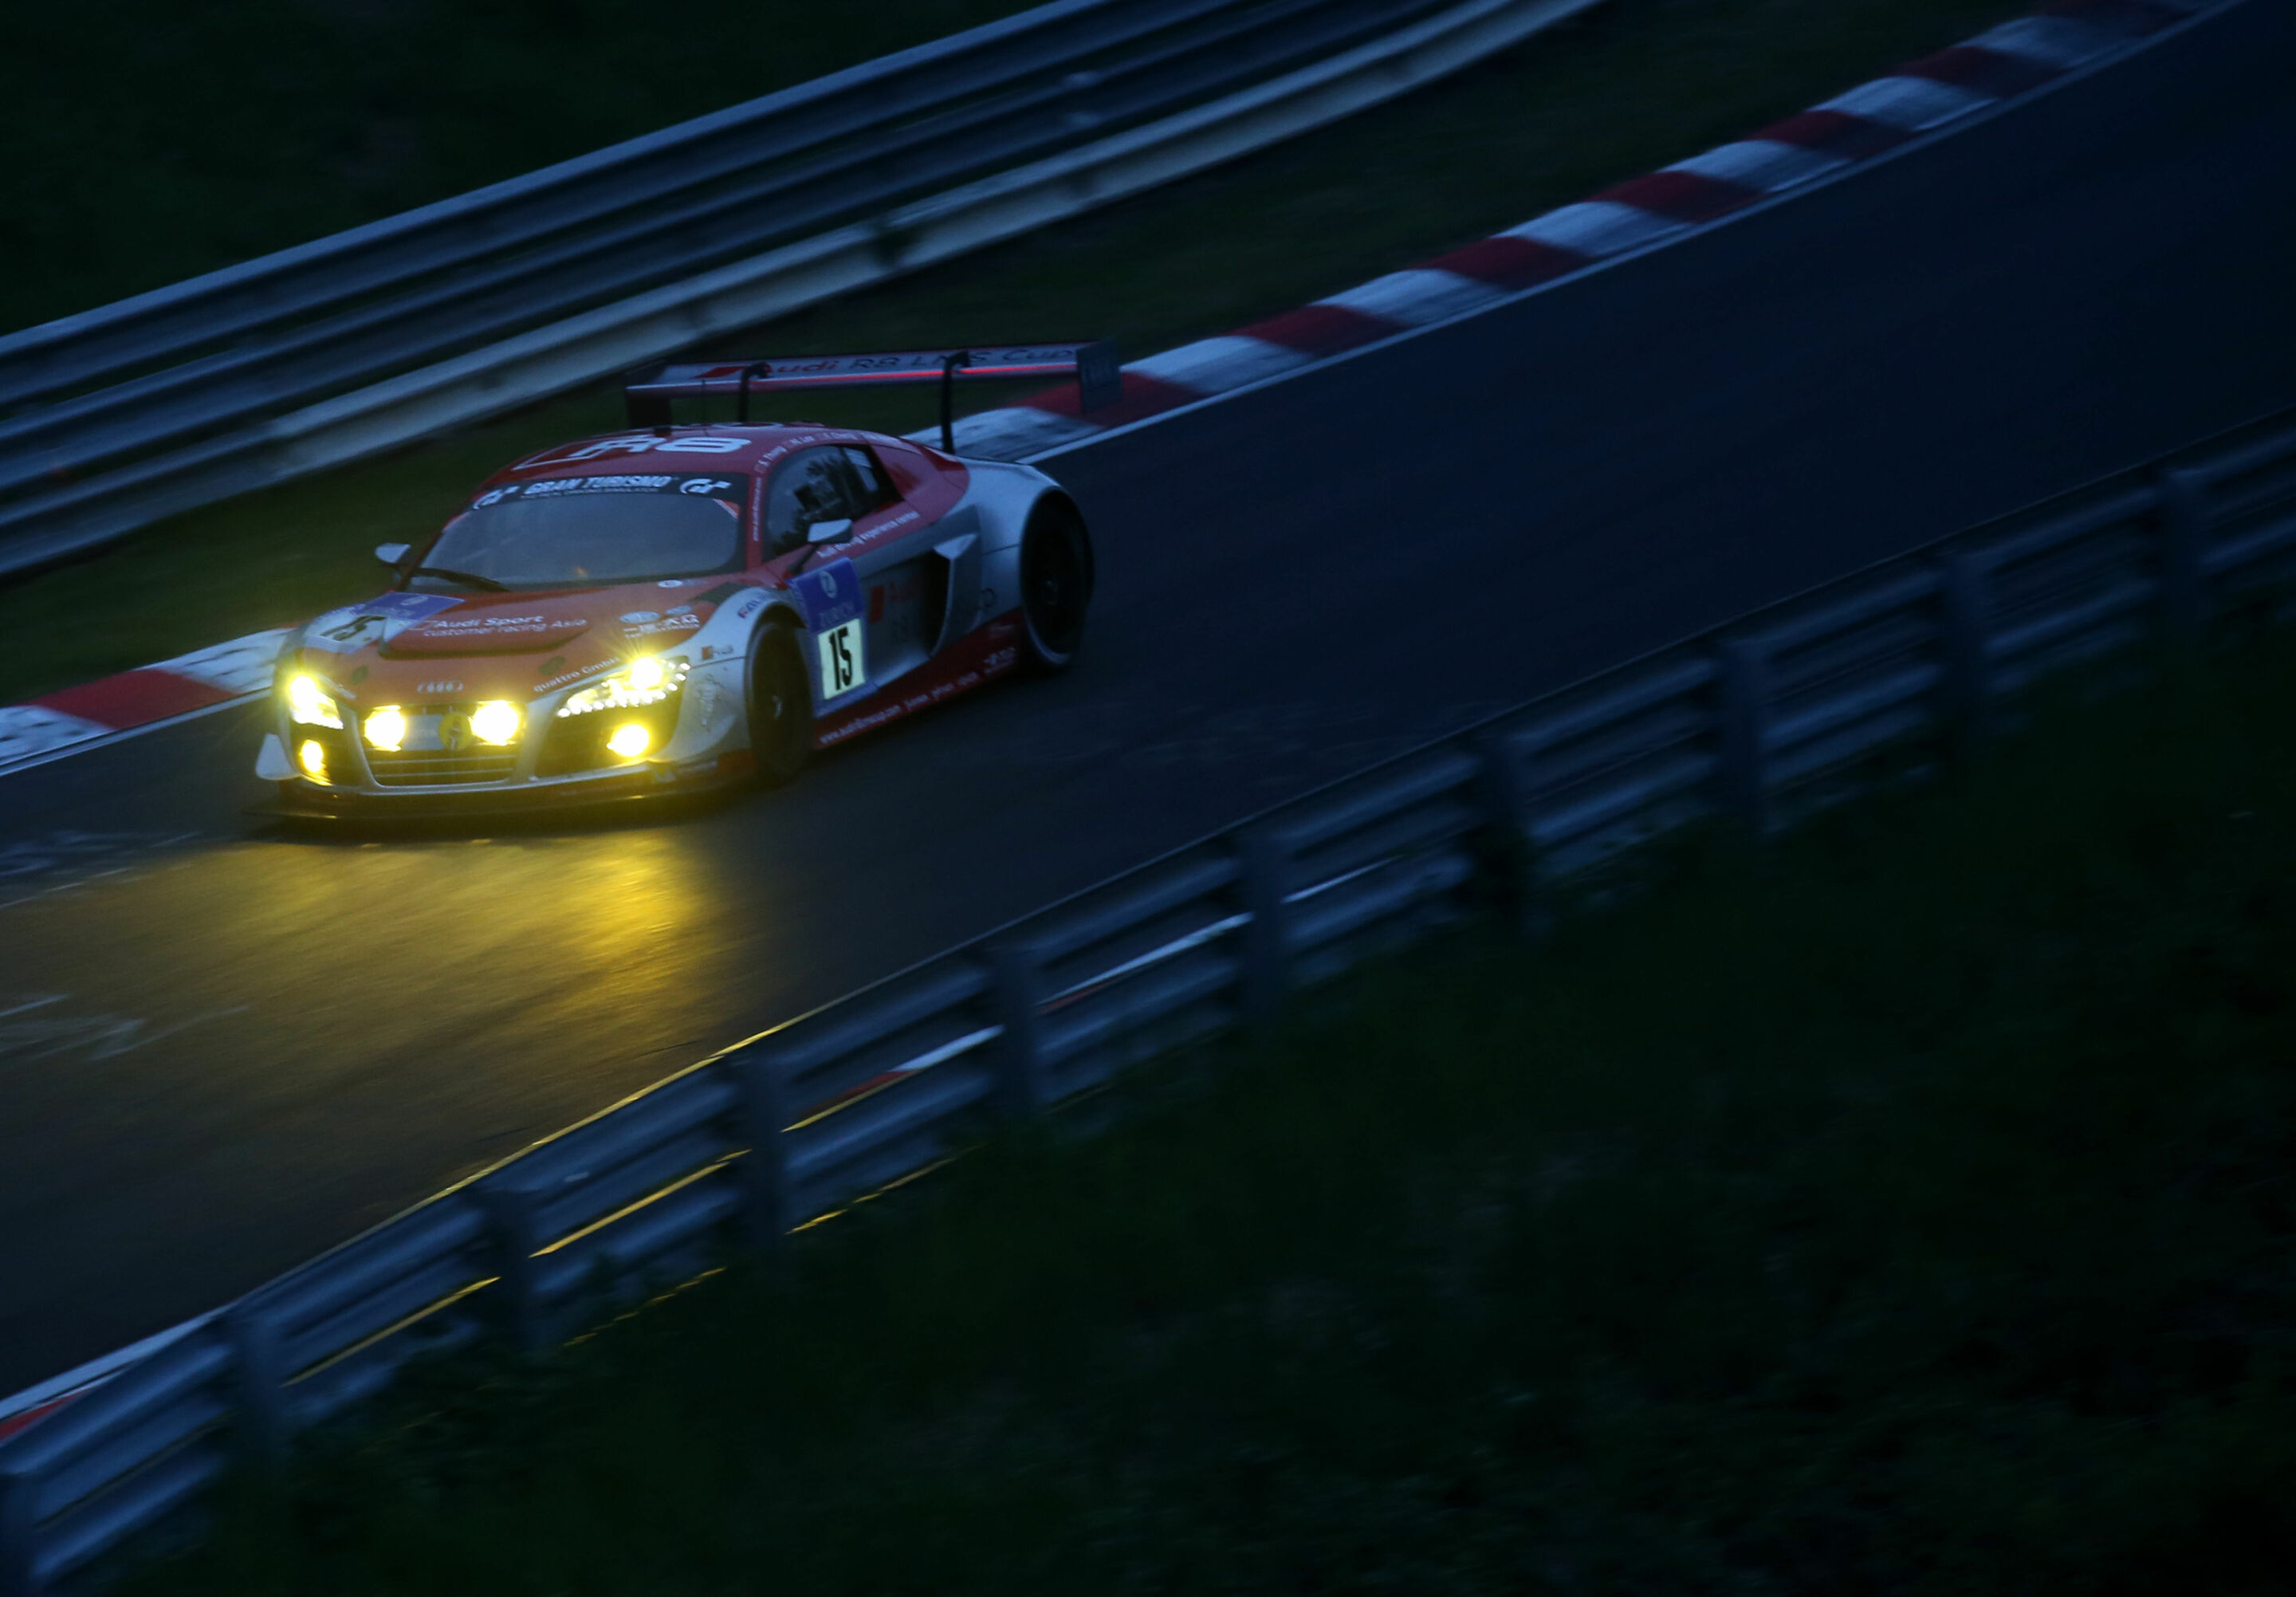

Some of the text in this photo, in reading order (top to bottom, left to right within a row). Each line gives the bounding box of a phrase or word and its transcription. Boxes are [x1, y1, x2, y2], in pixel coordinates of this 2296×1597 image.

[433, 615, 545, 628] Audi Sport
[828, 625, 853, 691] 15
[533, 670, 581, 693] quattro
